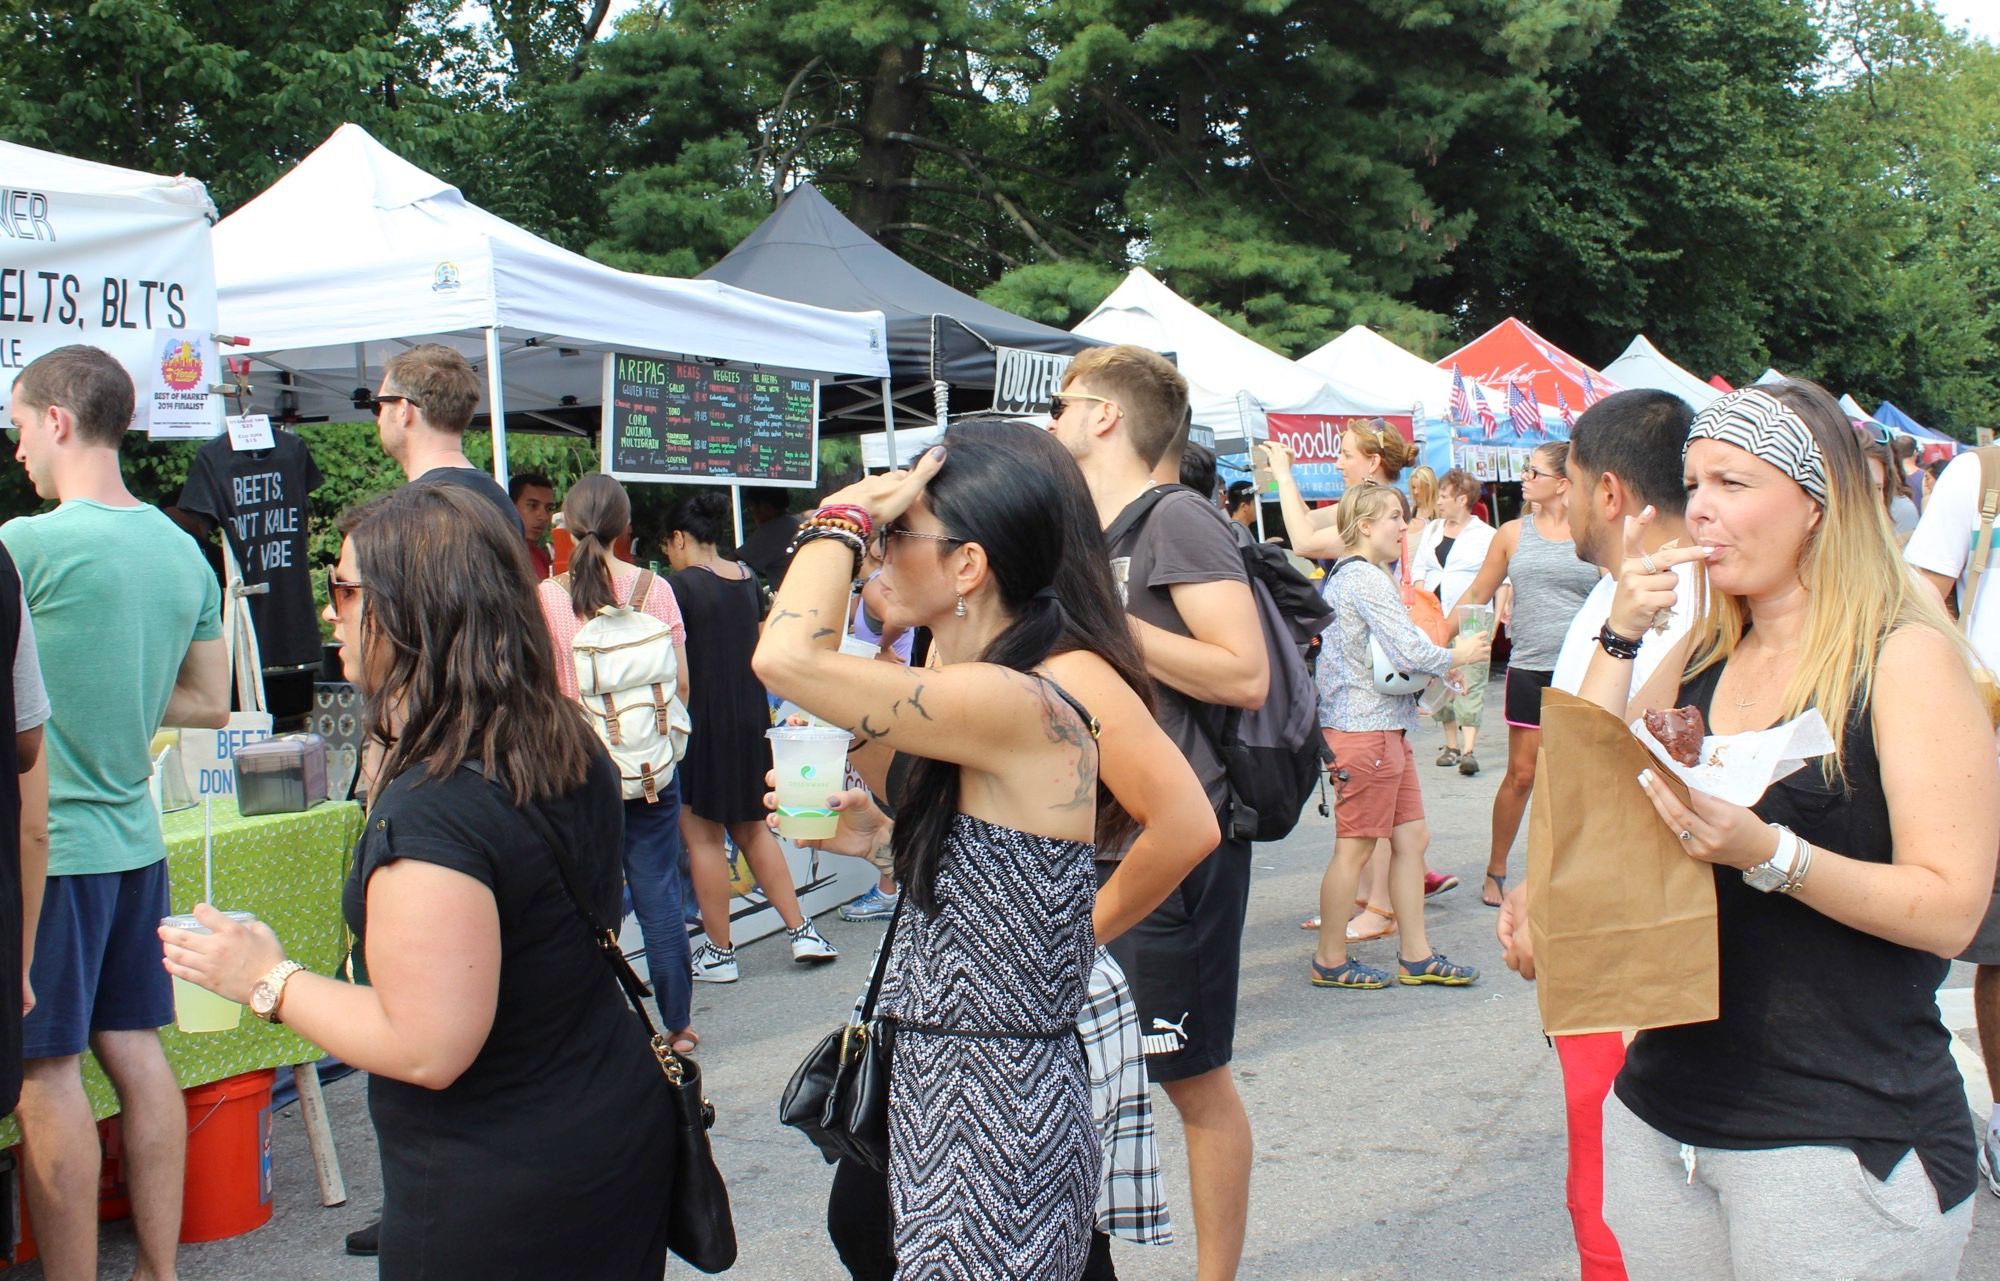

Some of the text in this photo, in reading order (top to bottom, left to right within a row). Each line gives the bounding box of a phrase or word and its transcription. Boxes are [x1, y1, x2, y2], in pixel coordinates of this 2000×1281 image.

[102, 277, 187, 330] BLT'S
[618, 358, 665, 385] AREPAS
[712, 369, 741, 383] VEGGIES
[154, 392, 170, 400] BEST
[181, 393, 209, 401] MARKET
[622, 384, 643, 398] GLUTEN
[645, 386, 660, 399] FREE
[174, 402, 205, 410] FINALIST
[628, 413, 648, 426] CORN
[625, 425, 652, 438] QUINOA
[620, 436, 660, 450] MULTIGRAIN
[232, 471, 284, 506] BEETS,
[264, 507, 298, 536] KALE
